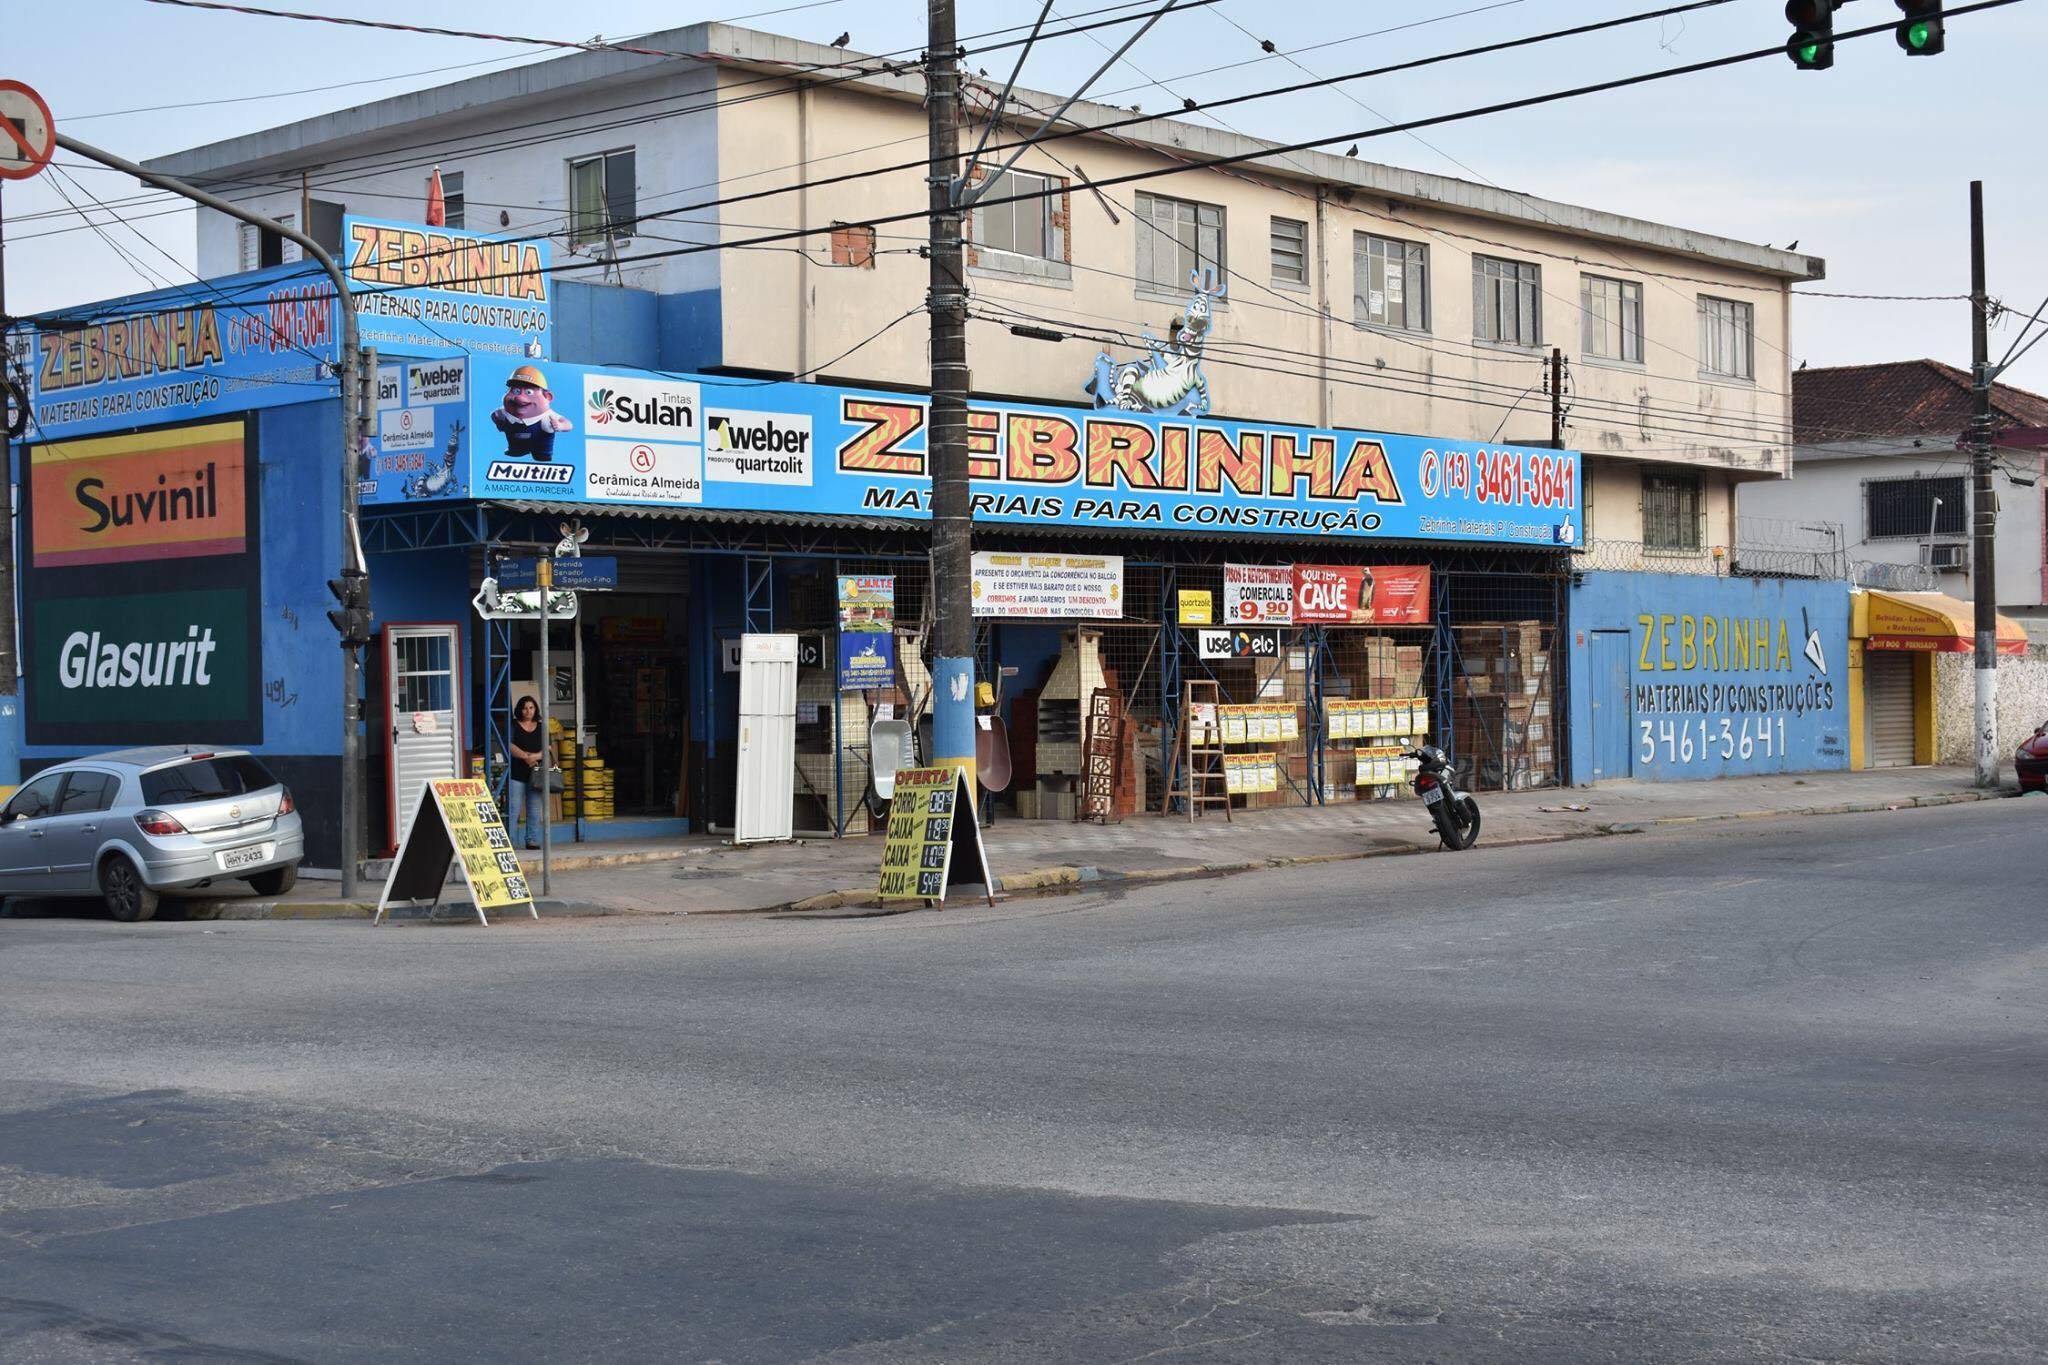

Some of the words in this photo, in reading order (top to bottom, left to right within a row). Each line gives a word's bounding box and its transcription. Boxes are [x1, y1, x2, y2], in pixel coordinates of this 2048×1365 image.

[351, 224, 546, 301] ZEBRINHA
[241, 314, 265, 356] (13)
[269, 281, 332, 354] 3461-3641
[353, 295, 421, 319] MATERIAIS
[425, 303, 458, 323] PARA
[462, 308, 547, 334] CONSTRUÇÃO
[359, 329, 405, 343] Zebrinha
[40, 303, 224, 393] ZEBRINHA
[421, 365, 463, 386] weber
[377, 380, 399, 400] lan
[424, 384, 460, 400] quartzolit
[661, 392, 692, 405] Tintas
[41, 398, 99, 425] MATERIAIS
[101, 392, 132, 417] PARA
[133, 378, 219, 412] CONSTRUÇÃO
[614, 396, 693, 428] Sulan
[410, 431, 434, 440] Almeida
[728, 420, 810, 454] weber
[493, 465, 568, 481] Multilit
[735, 456, 803, 475] quartzolit
[484, 484, 491, 492] A
[492, 484, 522, 493] MARCA
[522, 485, 534, 493] DA
[535, 486, 575, 495] PARCERIA
[588, 472, 648, 487] Cerâmica
[650, 476, 700, 490] Almeida
[1443, 451, 1470, 499] (13)
[1475, 449, 1575, 509] 3461-3641
[75, 462, 216, 533] Suvinil
[863, 487, 1063, 519] MARIAIS
[1072, 499, 1162, 523] PARA
[1173, 504, 1383, 534] CONSTRUÇÃO
[1420, 515, 1457, 533] Zebrinha
[1459, 519, 1496, 536] Materiais
[562, 576, 592, 585] Salgado
[975, 569, 1005, 577] APRESENTE
[1005, 569, 1010, 577] O
[1010, 570, 1041, 578] ORÇAMENTO
[1042, 570, 1049, 578] DA
[1051, 570, 1088, 579] CONCORRÊNCIA
[1089, 571, 1097, 579] NO
[1097, 571, 1117, 580] BALCÃO
[1225, 567, 1241, 583] PISOS
[1242, 568, 1247, 580] E
[1247, 568, 1293, 584] REVESTIMENTOS
[1302, 570, 1320, 583] AQUI
[1320, 571, 1337, 581] TEM
[1006, 582, 1028, 590] ESTIVER
[1029, 582, 1042, 590] MAIS
[1065, 583, 1076, 591] QUE
[1240, 587, 1285, 601] COMERCIAL
[1286, 588, 1293, 601] B
[1299, 577, 1348, 610] CAUÊ
[1068, 596, 1078, 604] UM
[1079, 596, 1107, 604] DESCONTO
[1180, 599, 1211, 608] quartzolit
[1008, 607, 1028, 615] MENOR
[1029, 607, 1048, 615] VALOR
[1064, 607, 1094, 616] CONDIÇÕES
[1206, 637, 1231, 654] use
[1637, 613, 1793, 672] ZEBRINHA
[59, 625, 216, 689] Glasurit
[1636, 684, 1709, 714] MATERIAIS
[1640, 717, 1786, 764] 3461-3641
[436, 782, 485, 797] OFERTA
[891, 791, 917, 814] FORRO
[889, 817, 914, 839] CAIXA
[885, 844, 910, 867] CAIXA
[880, 872, 905, 894] CAIXA
